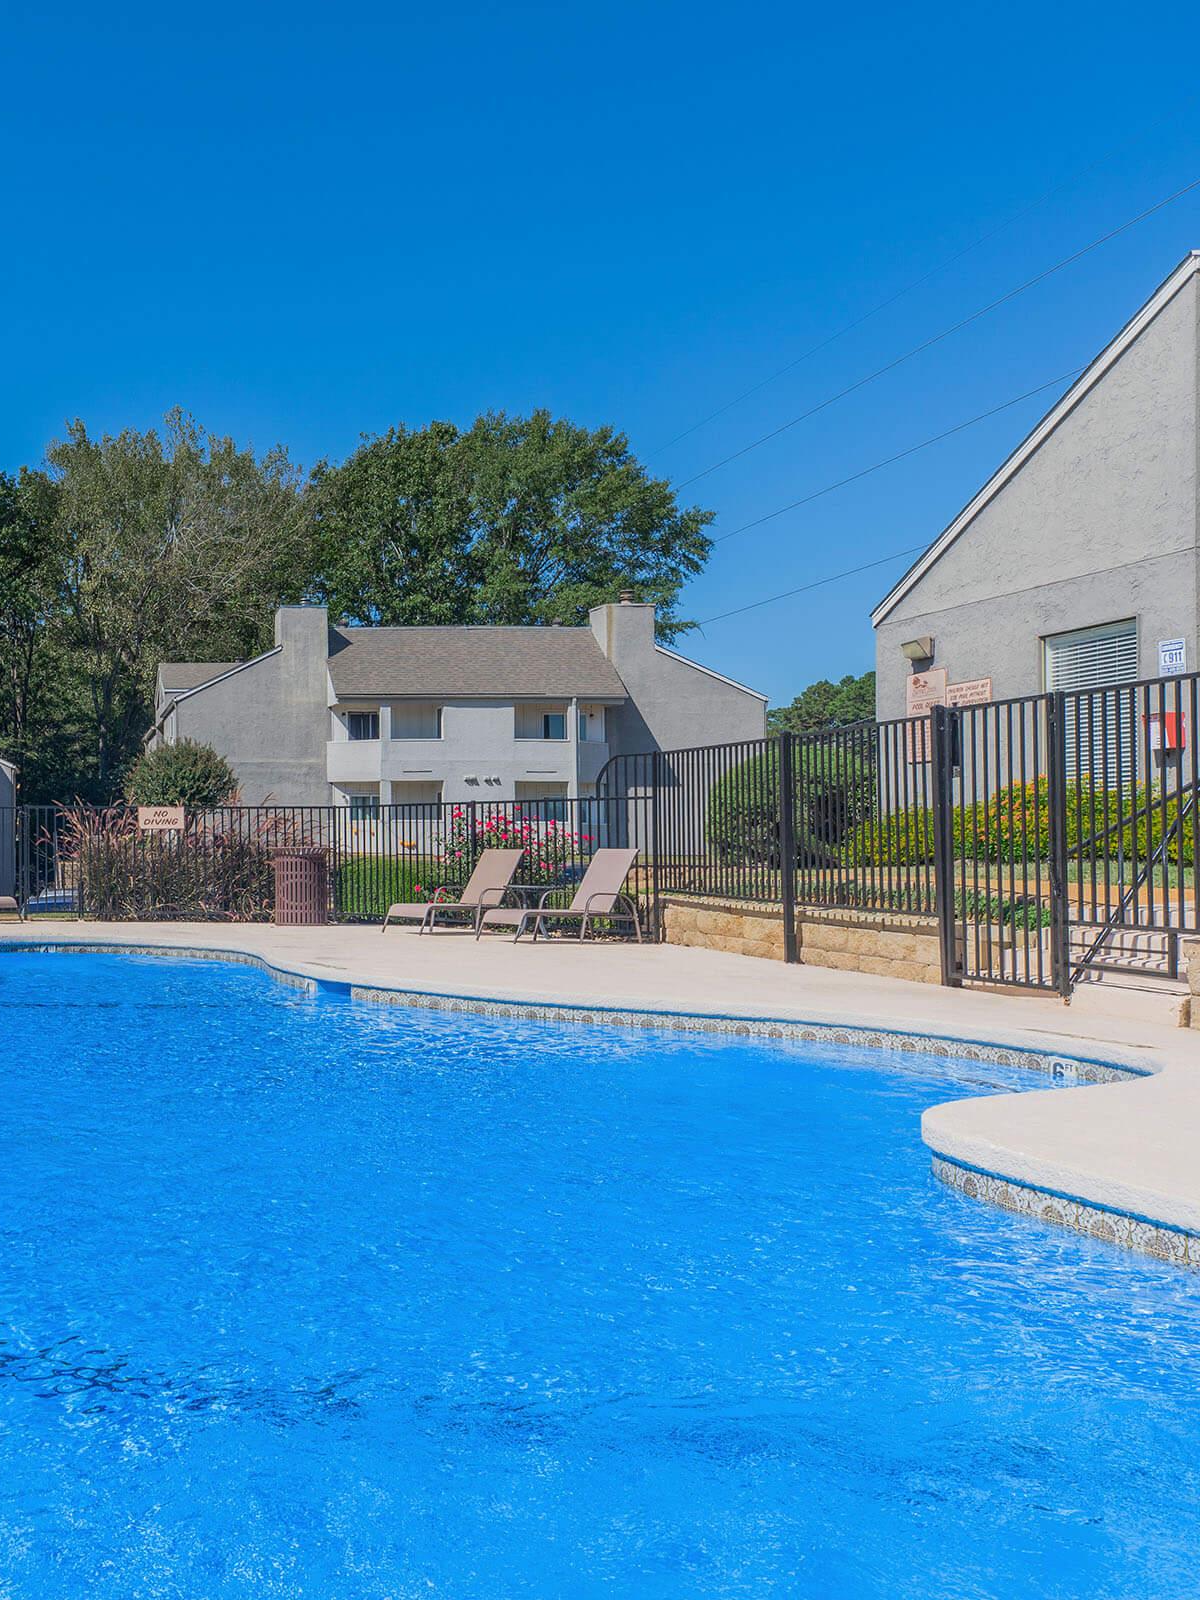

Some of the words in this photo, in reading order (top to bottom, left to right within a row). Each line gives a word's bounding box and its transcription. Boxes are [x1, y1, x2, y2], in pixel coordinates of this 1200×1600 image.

[1168, 652, 1182, 663] 911
[1052, 1062, 1064, 1077] 6
[1065, 1063, 1073, 1072] FT
